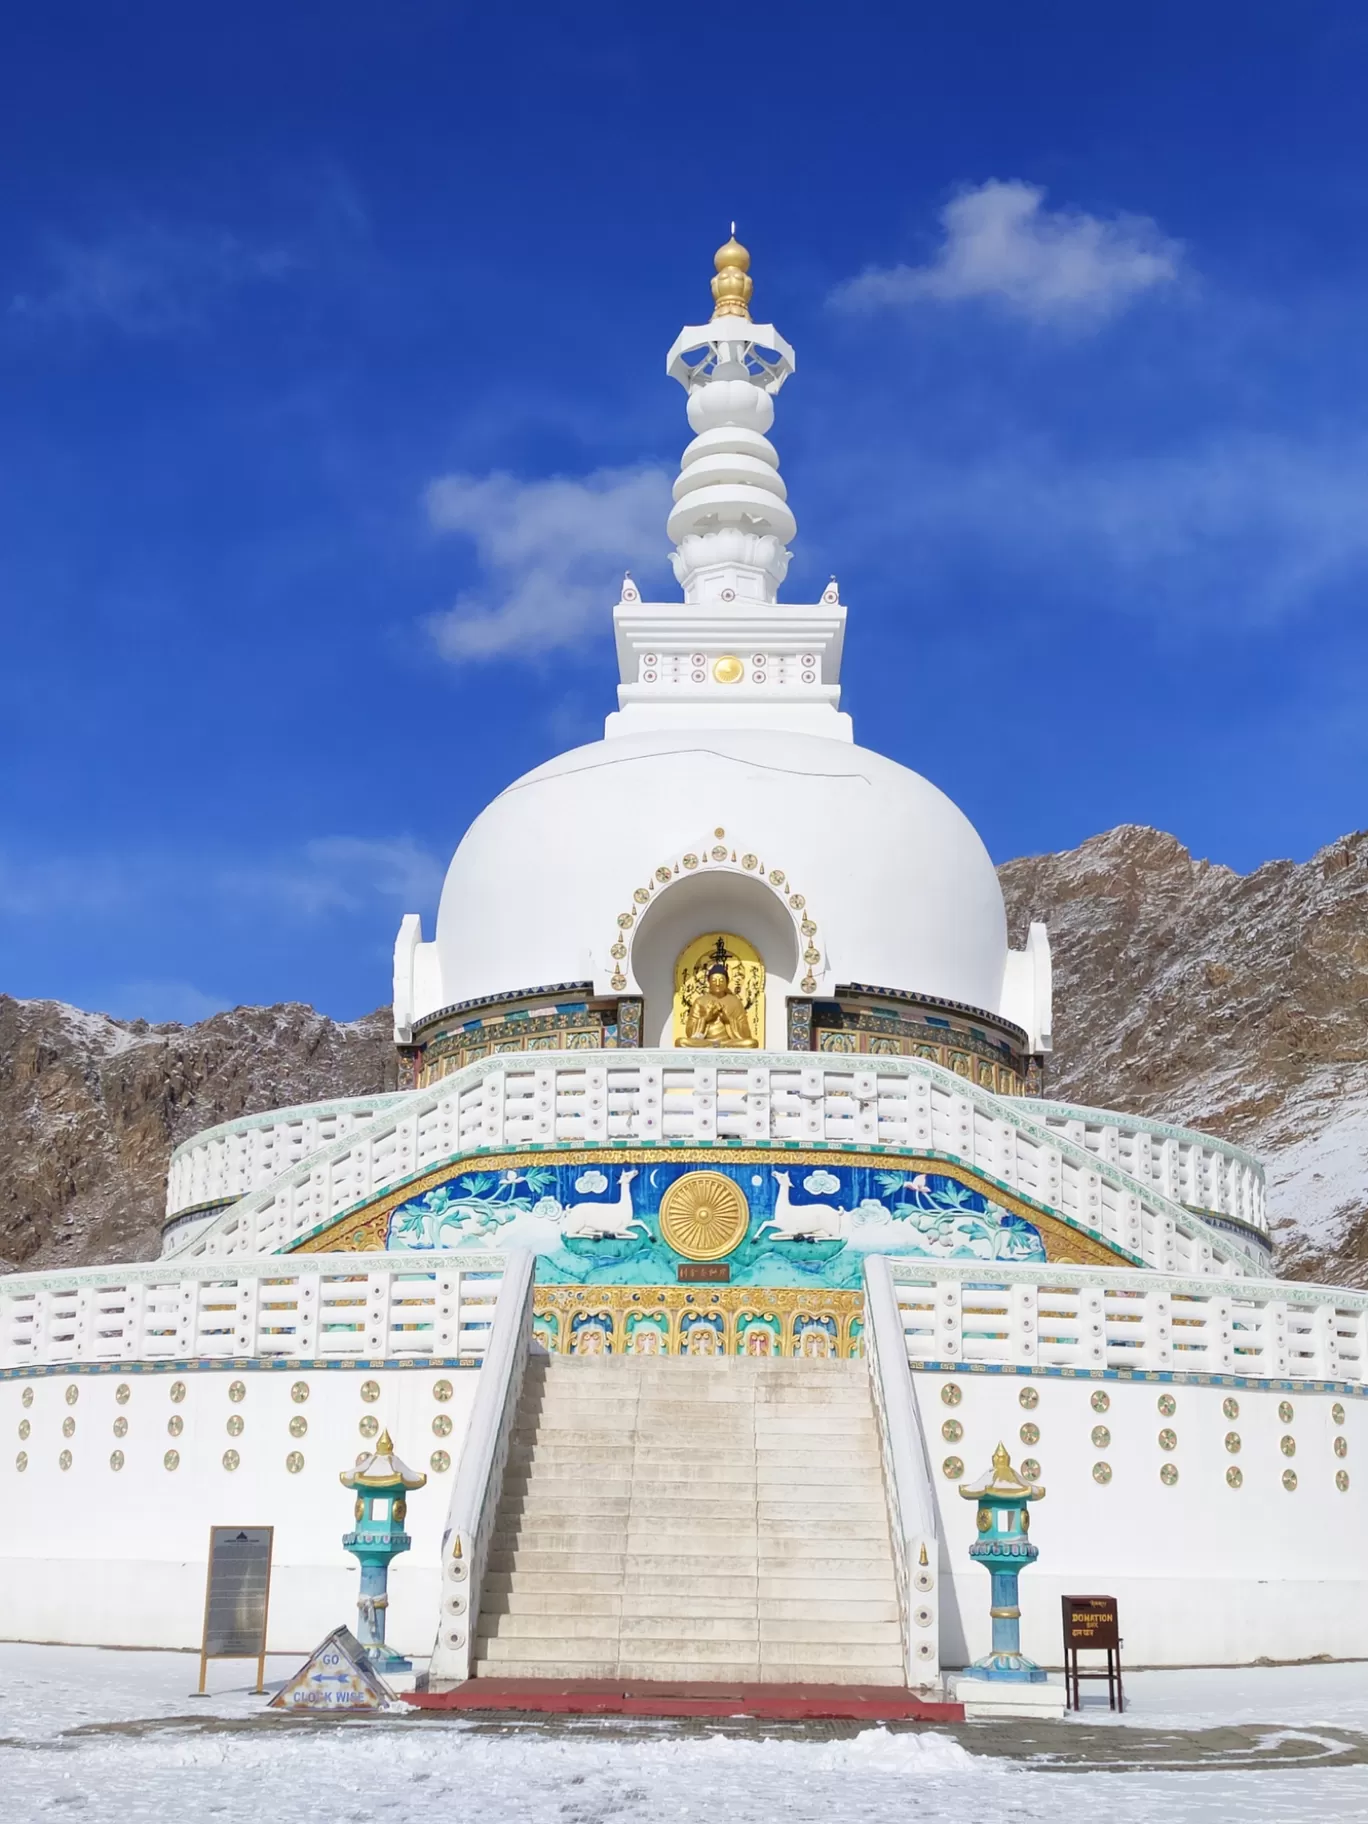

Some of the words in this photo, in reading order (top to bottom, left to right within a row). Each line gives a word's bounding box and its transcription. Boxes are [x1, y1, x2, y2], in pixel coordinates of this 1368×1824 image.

[1072, 1613, 1113, 1622] DONATION
[323, 1654, 340, 1665] GO
[336, 1691, 365, 1703] WISE
